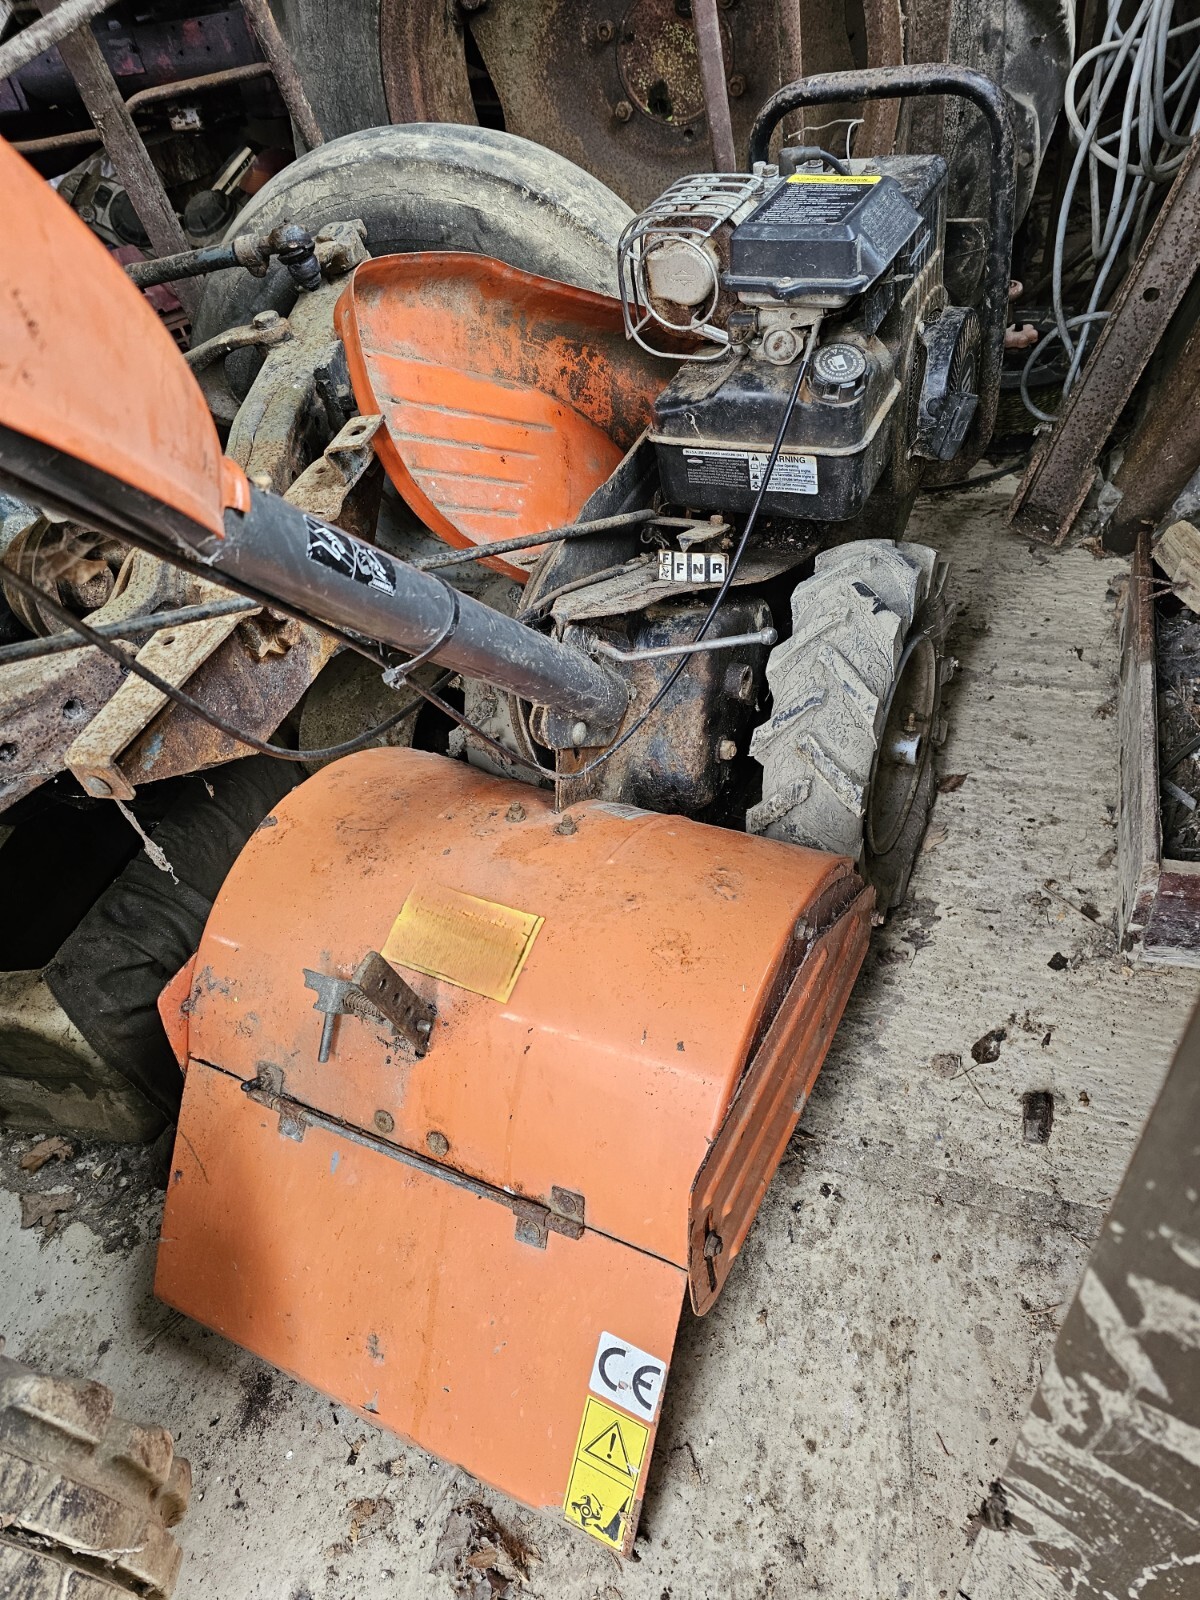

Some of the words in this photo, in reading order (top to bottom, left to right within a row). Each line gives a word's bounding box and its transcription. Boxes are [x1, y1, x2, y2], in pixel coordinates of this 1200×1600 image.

[677, 563, 684, 573] F
[693, 564, 703, 574] N
[713, 564, 722, 573] R
[598, 1348, 662, 1411] CE
